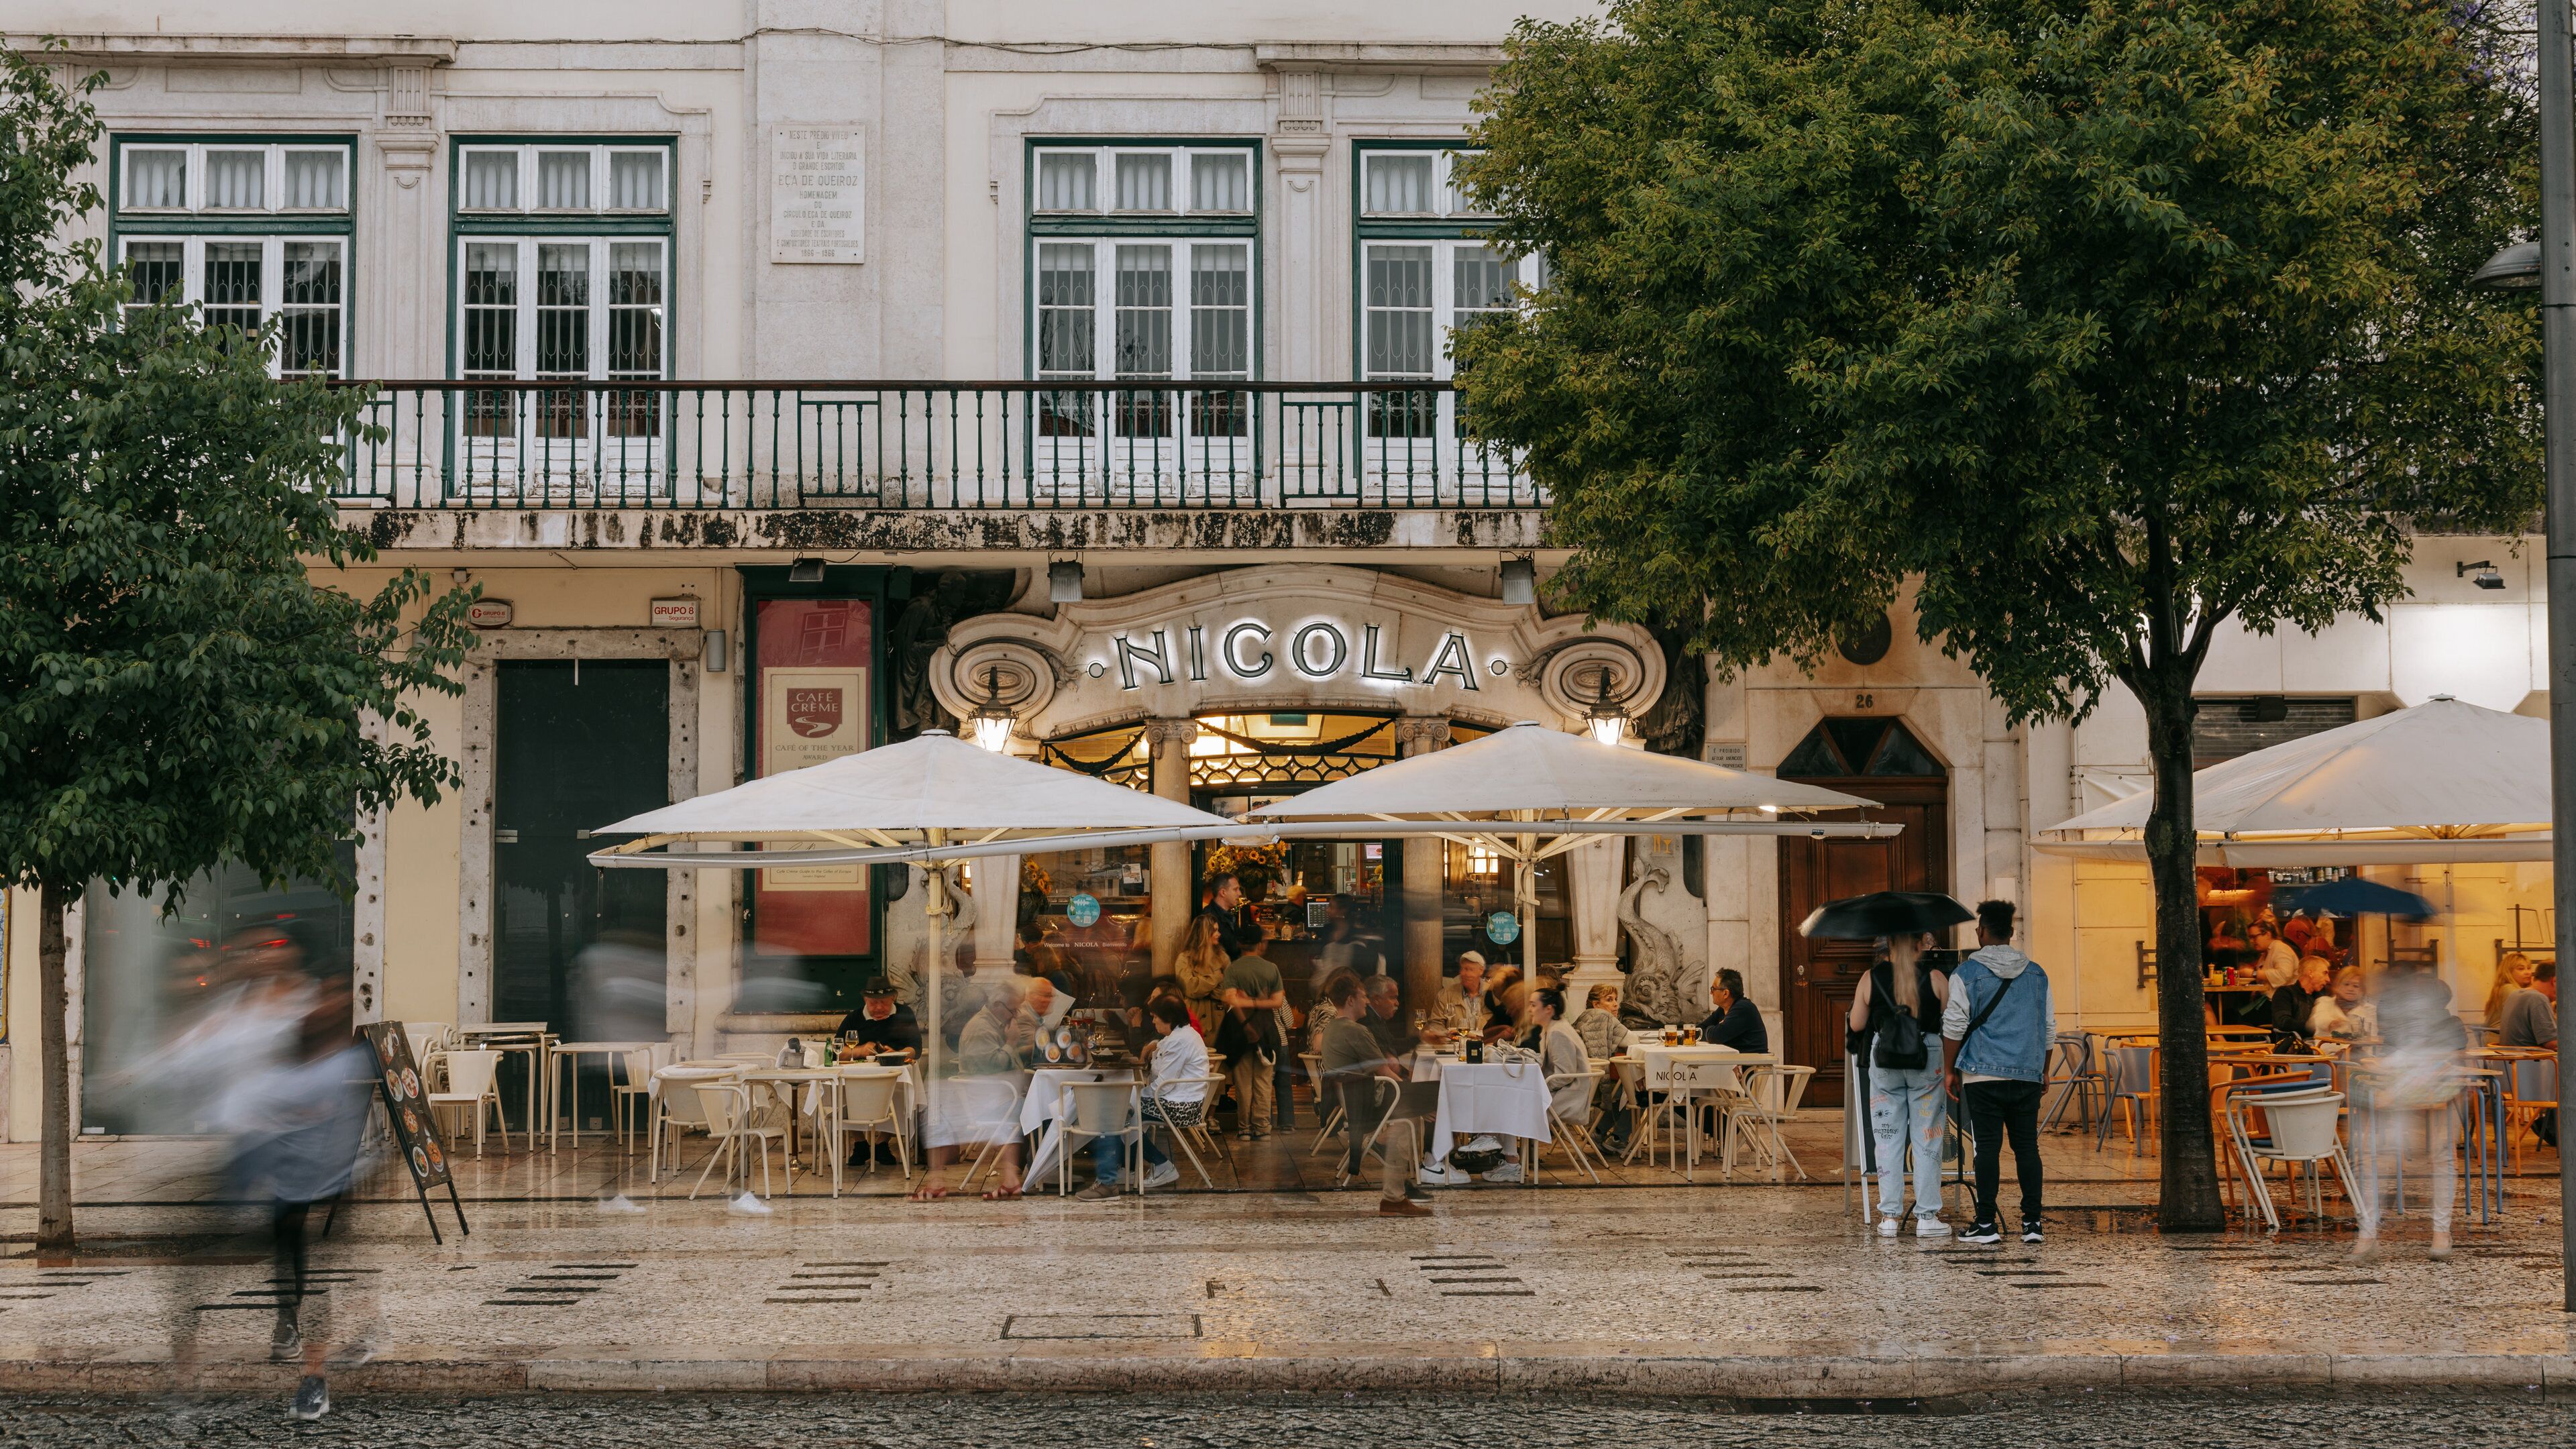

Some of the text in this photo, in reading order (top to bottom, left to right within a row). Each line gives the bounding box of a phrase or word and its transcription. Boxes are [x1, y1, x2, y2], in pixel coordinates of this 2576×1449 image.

[789, 130, 807, 140] NESTE
[831, 130, 849, 140] VIVEU
[799, 152, 803, 160] A
[805, 152, 814, 160] SUA
[816, 152, 828, 160] VIDA
[821, 162, 845, 170] ESCRITOR
[778, 175, 858, 187] EÇA DE QUEIROZ
[799, 191, 837, 199] HOMENAGEM
[820, 211, 828, 219] DE
[829, 211, 852, 219] QUEIROZ
[817, 220, 824, 228] DA
[822, 249, 835, 257] 1966
[654, 606, 694, 614] GRUPO 8
[1114, 621, 1480, 692] NICOLA
[796, 691, 833, 702] CAFÉ
[1856, 694, 1873, 708] 26
[791, 702, 838, 712] CRÈME
[775, 743, 796, 751] CAFÉ
